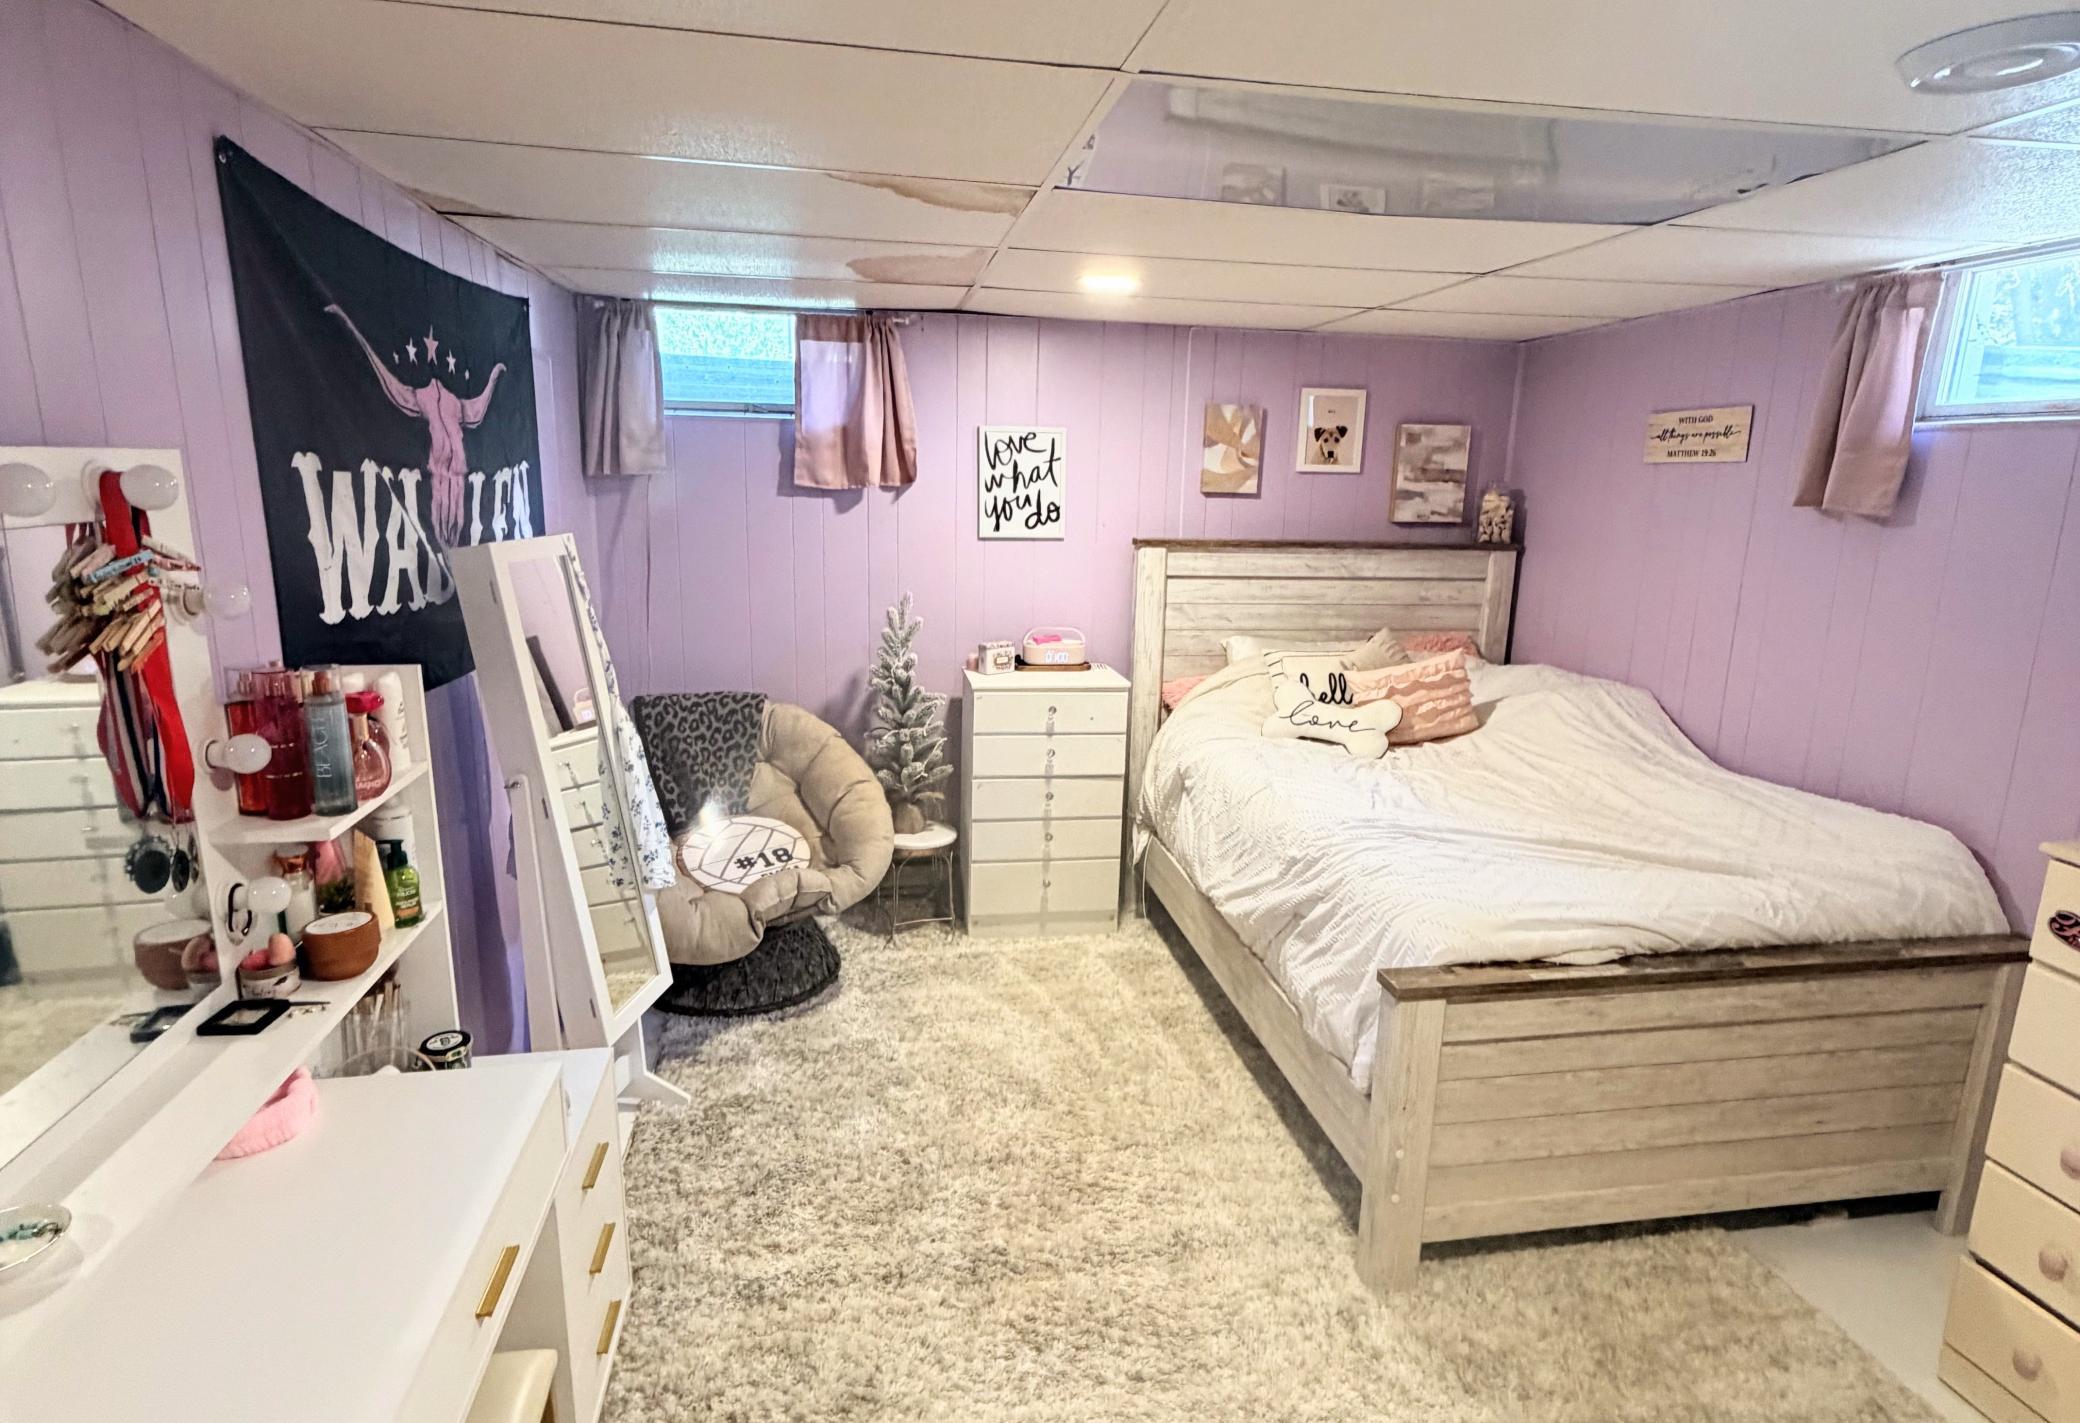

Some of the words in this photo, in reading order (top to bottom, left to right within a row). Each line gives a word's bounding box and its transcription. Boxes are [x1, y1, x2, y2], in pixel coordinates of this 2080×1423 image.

[1678, 416, 1697, 425] WITH
[1698, 414, 1714, 424] GOD
[1667, 427, 1690, 445] things
[1702, 424, 1741, 444] possible
[1666, 450, 1700, 458] MATTHEW
[984, 437, 1061, 494] what
[984, 493, 1032, 532] you
[1024, 488, 1061, 530] do
[734, 847, 794, 870] #18
